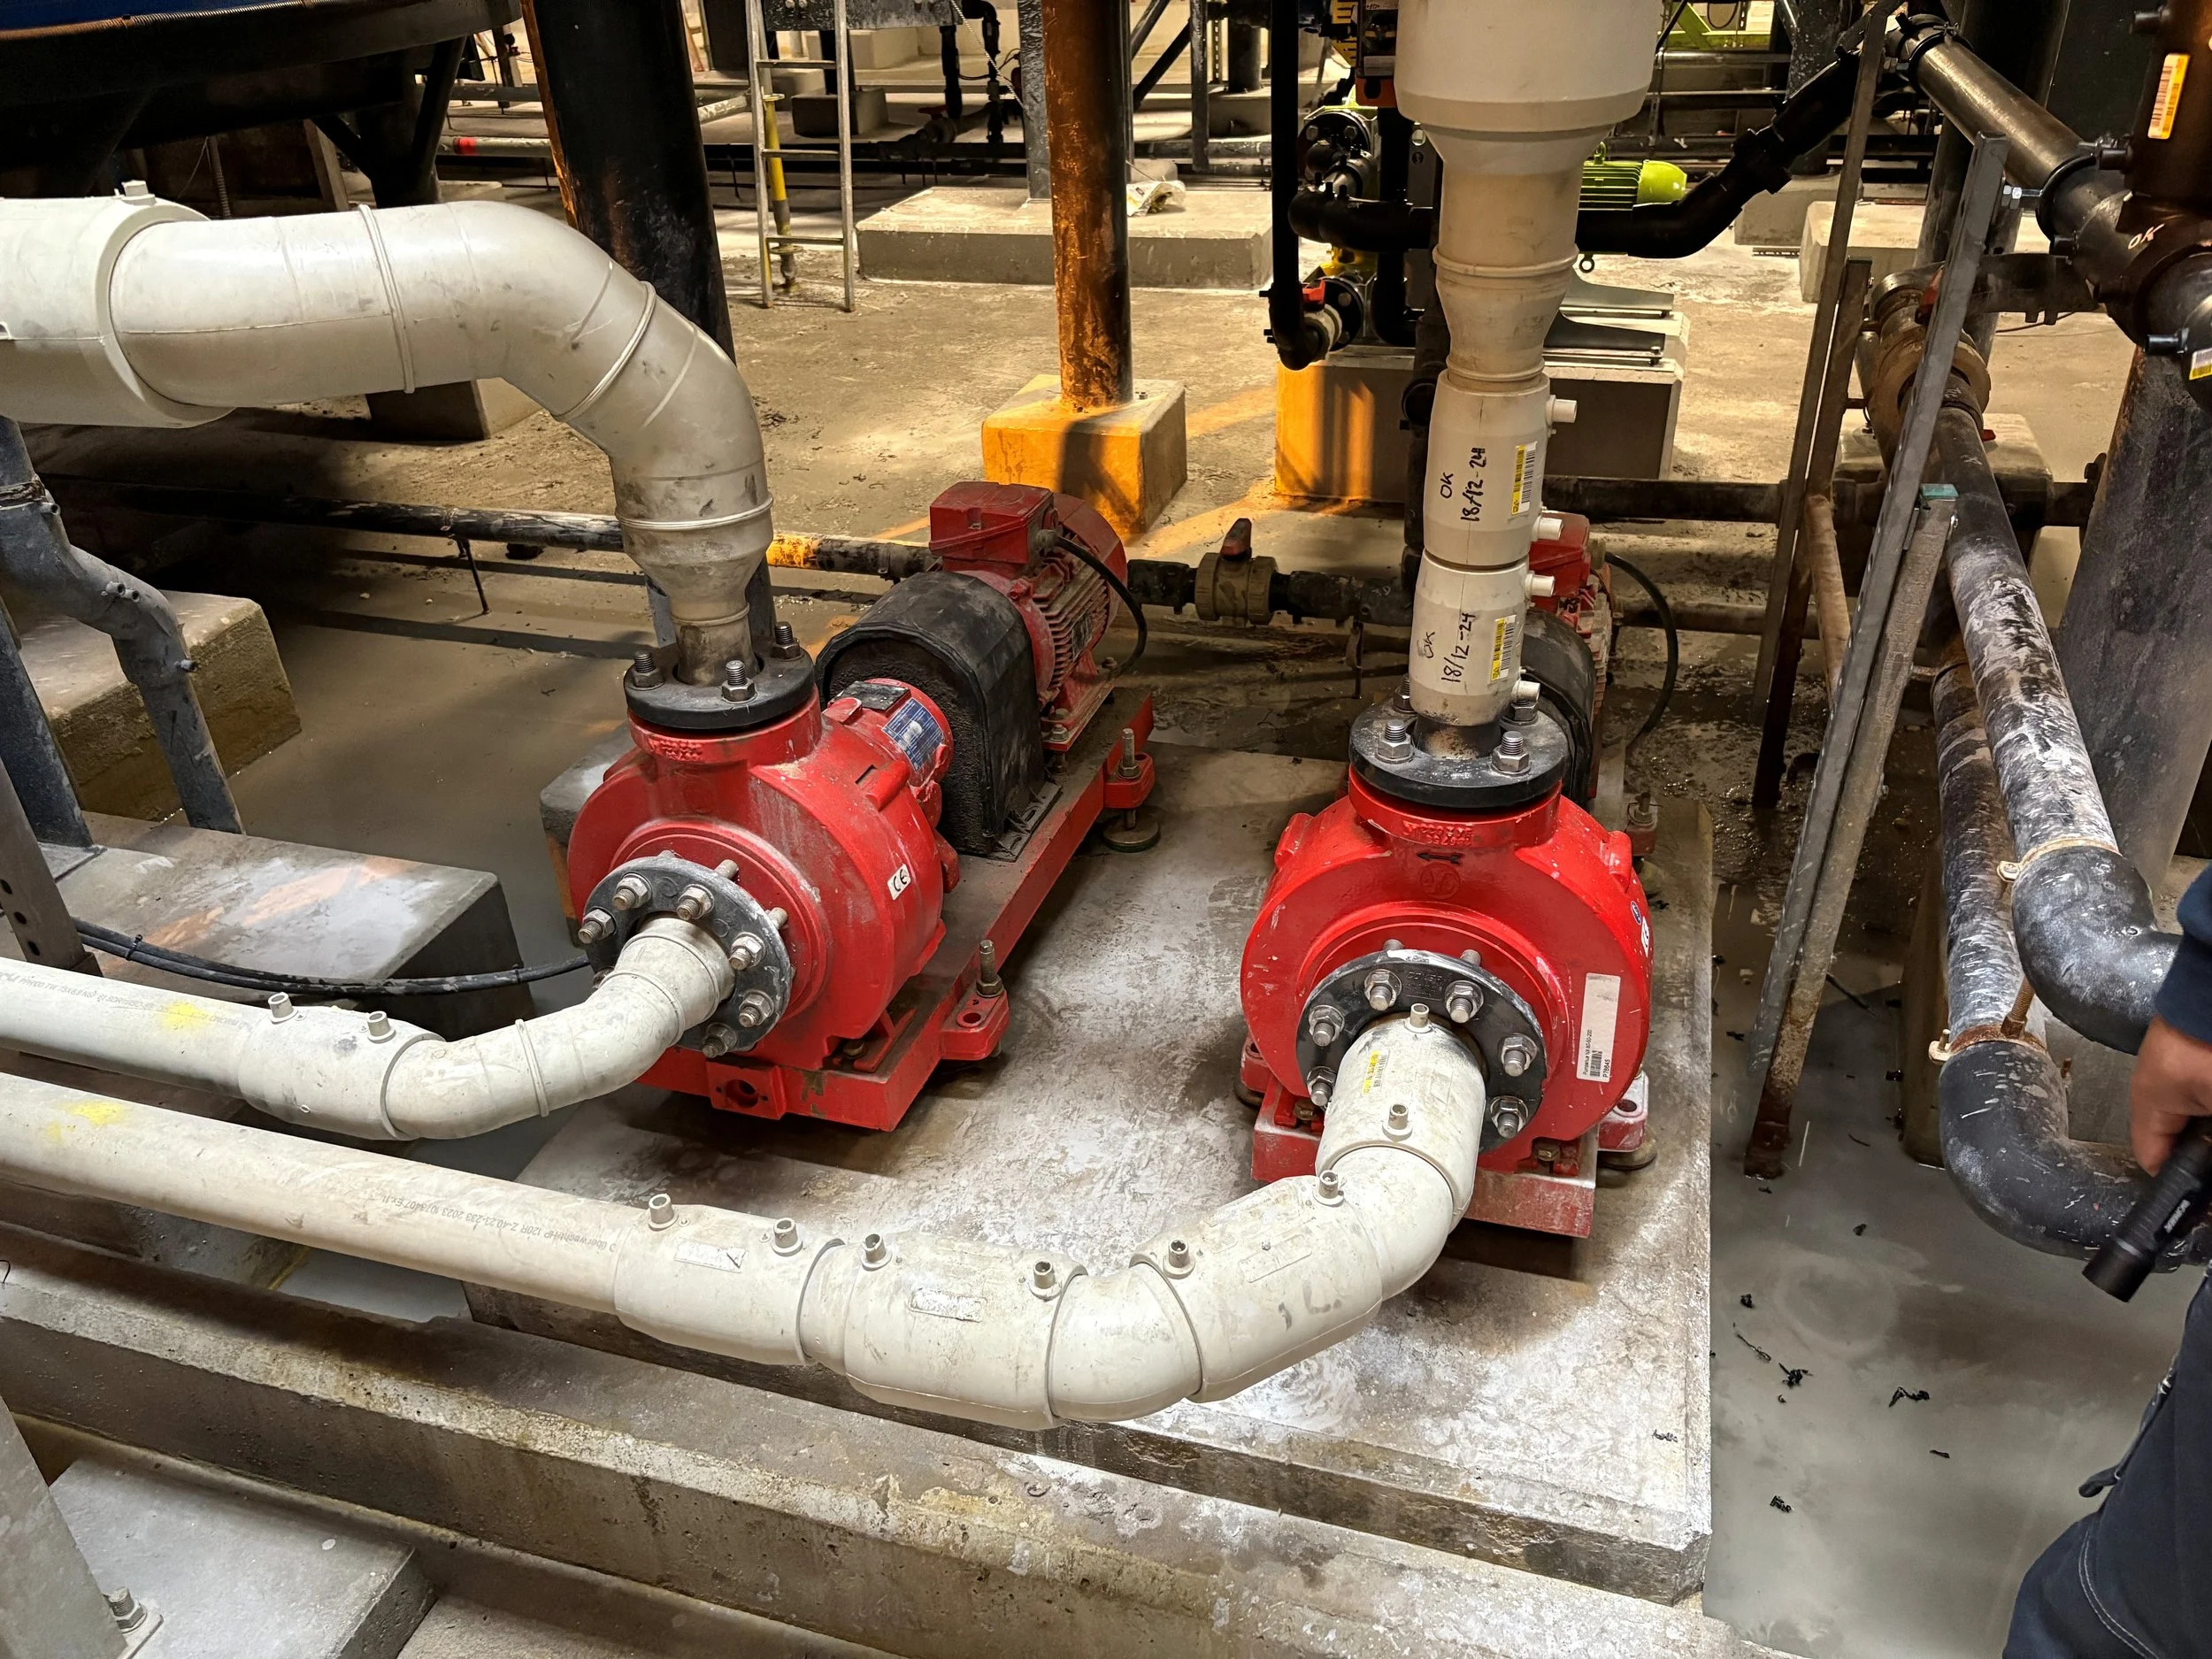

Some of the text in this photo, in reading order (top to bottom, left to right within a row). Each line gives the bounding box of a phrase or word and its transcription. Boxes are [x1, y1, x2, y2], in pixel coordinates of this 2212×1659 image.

[2127, 223, 2165, 250] OK
[1440, 472, 1454, 498] OK
[442, 1207, 465, 1218] 2023
